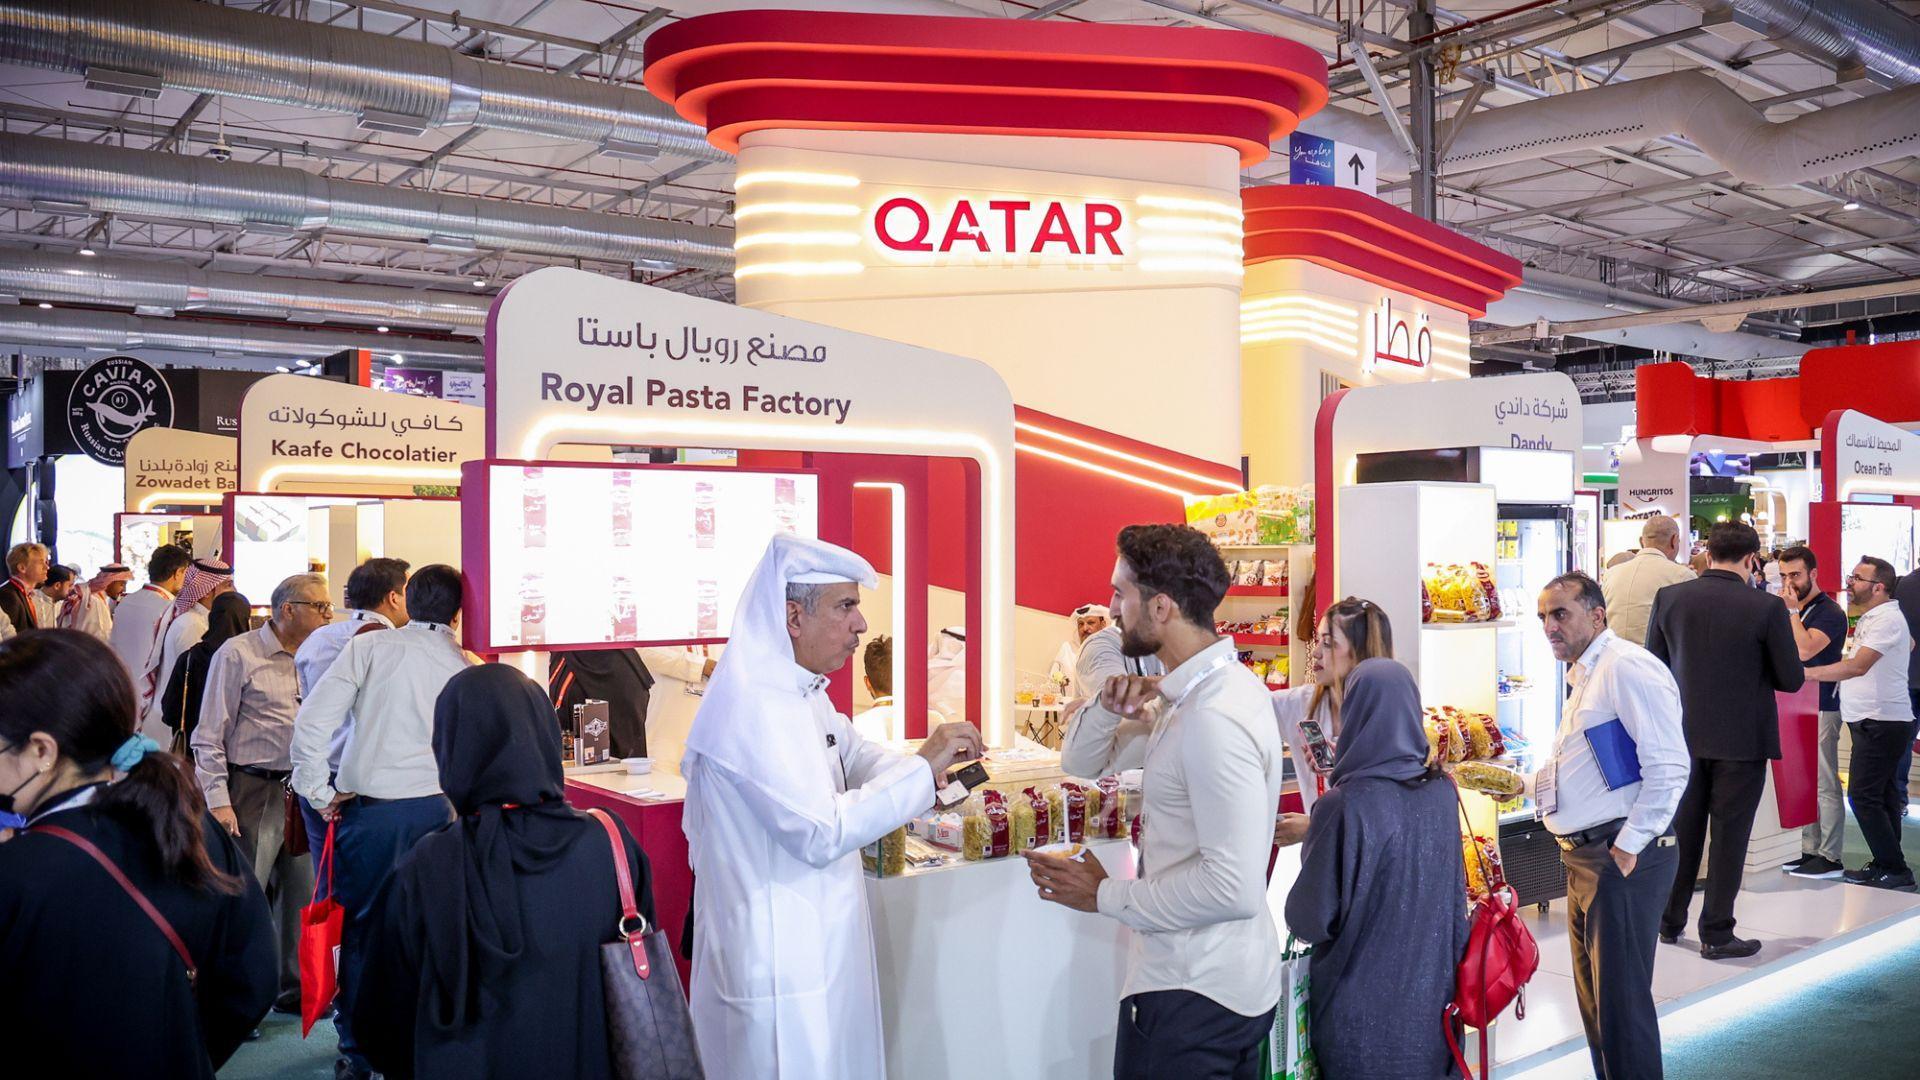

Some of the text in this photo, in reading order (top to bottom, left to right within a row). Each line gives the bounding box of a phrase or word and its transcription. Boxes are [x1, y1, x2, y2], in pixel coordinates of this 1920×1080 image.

[874, 197, 1124, 255] QATAR
[578, 316, 827, 366] مصنع رويال باستا
[1363, 297, 1432, 374] قطر
[83, 366, 157, 397] CAVIAR
[541, 372, 852, 425] Royal Pasta Factory
[1495, 397, 1568, 425] شركة داندي
[216, 415, 238, 426] Rus
[268, 406, 463, 437] كافي للشوكولاته
[81, 423, 106, 454] Russian
[271, 439, 457, 463] Kaafe Chocolatier
[1877, 436, 1902, 453] المحيط
[140, 459, 173, 474] بلدنا
[175, 459, 208, 475] زوادة
[1854, 460, 1893, 476] Ocean Fish
[135, 475, 236, 490] Zowadet Ba
[1629, 488, 1674, 496] HUNGRITOS
